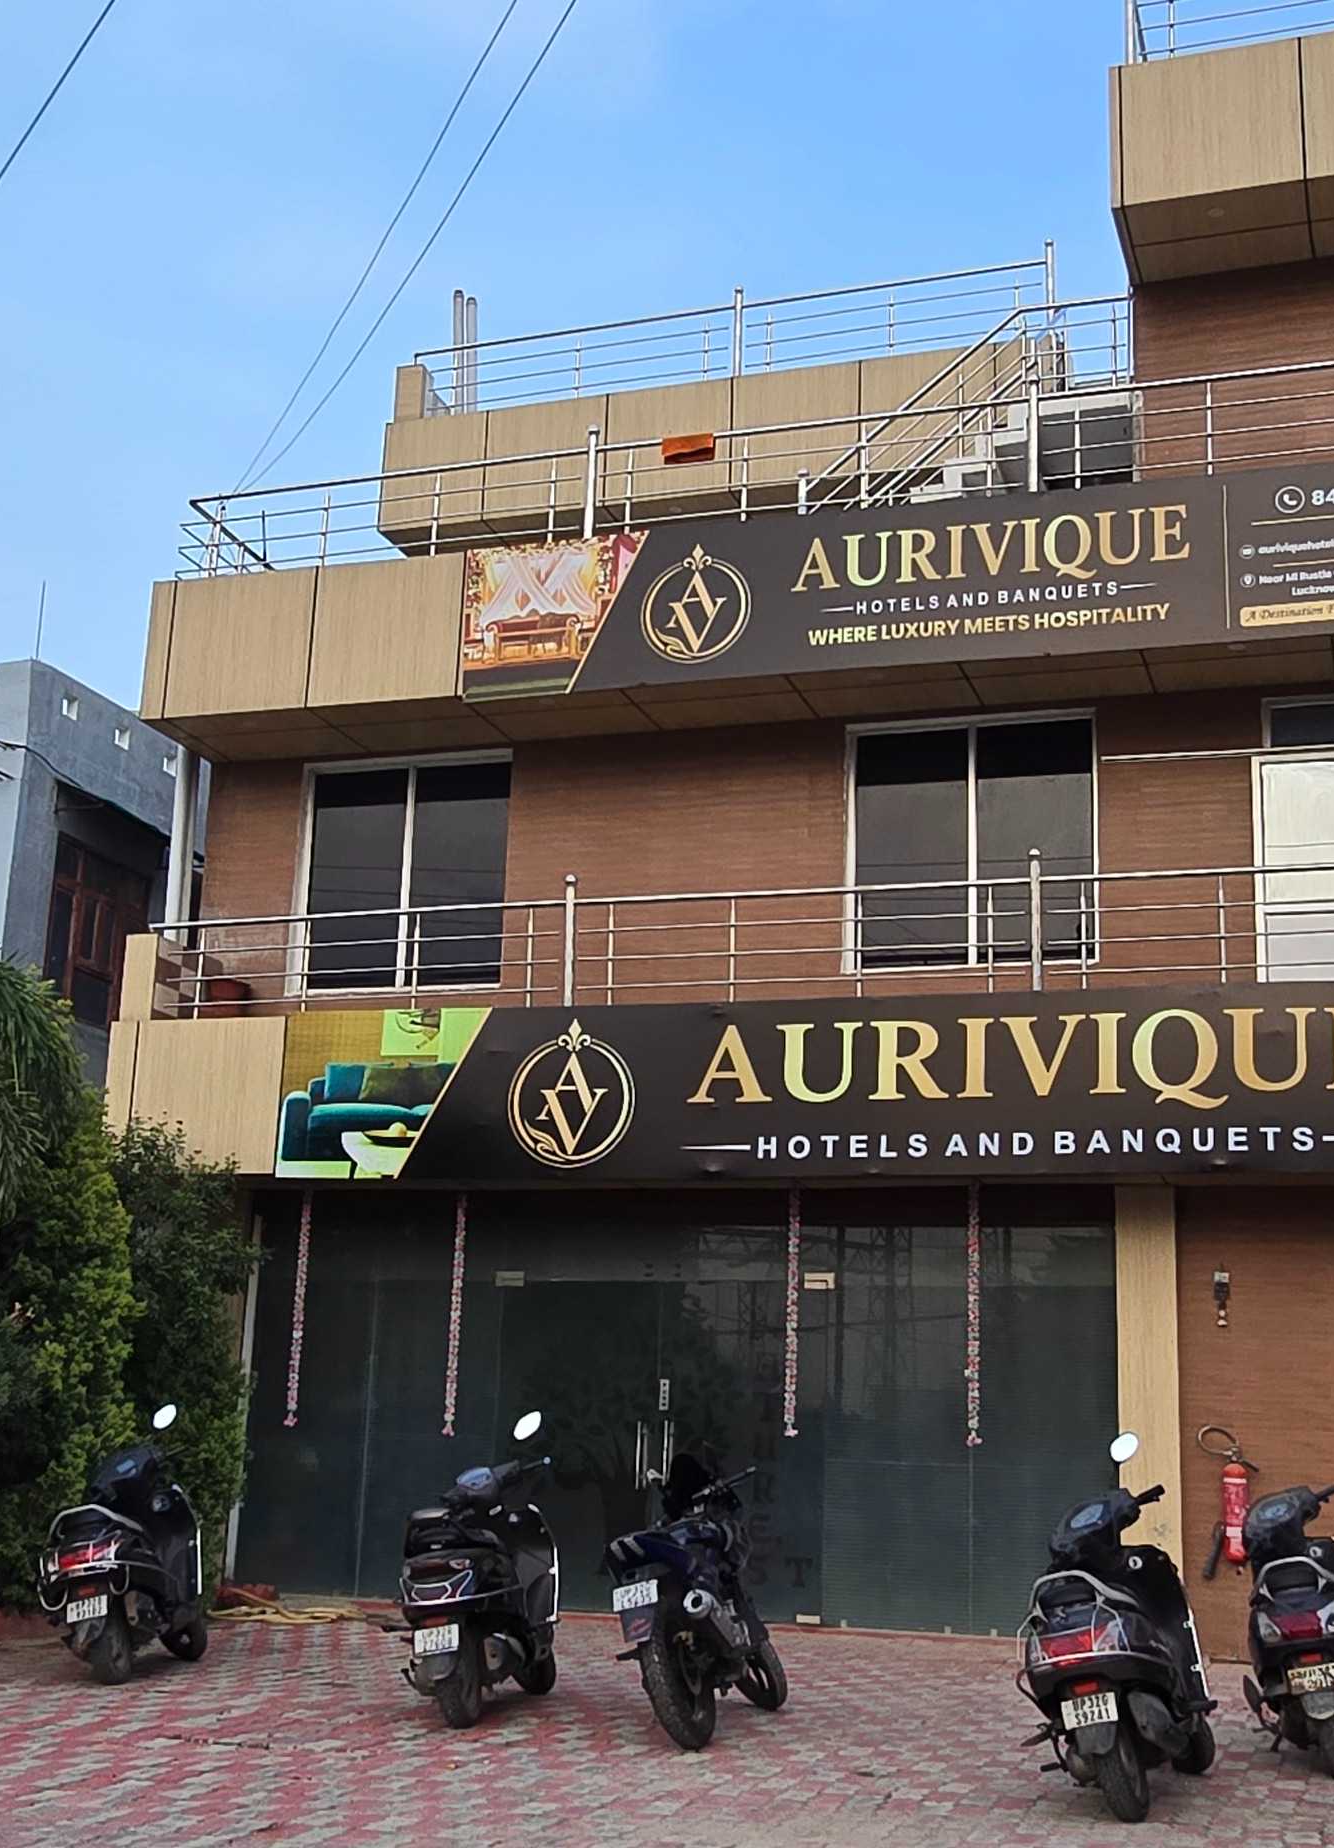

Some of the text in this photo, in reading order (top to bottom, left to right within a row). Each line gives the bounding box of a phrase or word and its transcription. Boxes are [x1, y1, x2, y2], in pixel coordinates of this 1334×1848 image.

[791, 504, 1190, 592] AURIVIQUE
[855, 581, 1119, 616] HOTELS AND BANQUETS
[1245, 611, 1257, 623] A
[1260, 606, 1324, 621] Destination
[807, 603, 1170, 646] WHERE LUXURY MEETS HOSPITALITY
[757, 1126, 1316, 1160] HOTELS AND BANQUETS
